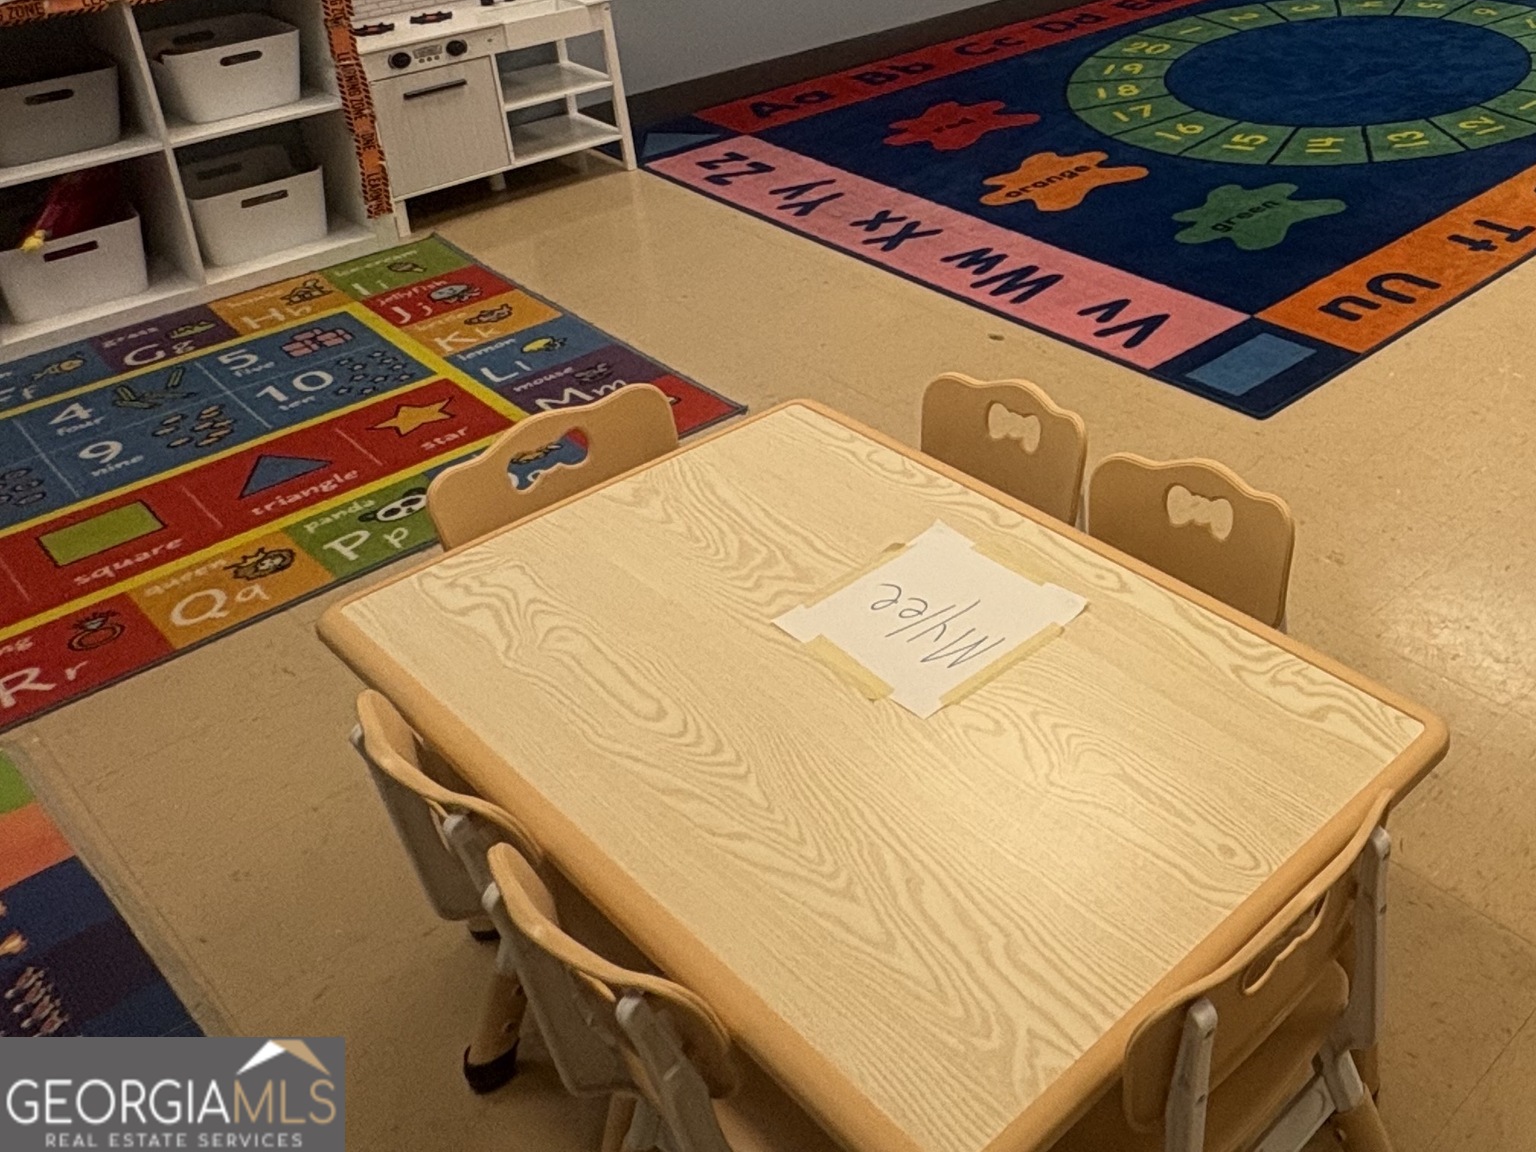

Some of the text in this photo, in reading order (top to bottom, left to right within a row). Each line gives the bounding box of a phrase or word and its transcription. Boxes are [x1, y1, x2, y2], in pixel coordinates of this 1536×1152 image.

[11, 2, 45, 20] ZONE
[1290, 3, 1322, 13] 3
[1355, 0, 1385, 9] 4
[1416, 1, 1447, 10] 5
[1471, 7, 1500, 18] 6
[1228, 11, 1260, 24] 2
[1178, 26, 1202, 36] 1
[1120, 40, 1172, 56] 20
[748, 89, 837, 120] Aa
[851, 60, 936, 87] Bb
[953, 35, 1027, 57] Cc
[1032, 11, 1108, 36] Dd
[1103, 61, 1145, 77] 19
[1096, 83, 1141, 100] 18
[351, 97, 368, 121] ZONE
[1112, 103, 1154, 123] 17
[1154, 121, 1206, 142] 16
[1457, 115, 1507, 137] 12
[361, 132, 377, 152] ONE
[1221, 132, 1270, 152] 15
[1303, 135, 1347, 155] 14
[1386, 129, 1431, 150] 13
[1004, 163, 1092, 199] orange
[1210, 197, 1281, 234] green
[1446, 218, 1536, 253] Tt
[695, 150, 1172, 349] Vv Ww Xx Yy Zz
[1317, 270, 1443, 323] Uu
[217, 348, 260, 372] 5
[458, 335, 516, 362] lemon
[255, 369, 334, 403] 10
[513, 365, 574, 393] mouse
[48, 401, 96, 426] 4
[56, 415, 105, 436] four
[420, 425, 469, 451] star
[78, 439, 124, 465] 9
[91, 453, 145, 478] nine
[251, 468, 359, 516] triangle
[303, 498, 377, 534] panda
[73, 537, 183, 587] square
[144, 557, 228, 598] queen
[869, 583, 1006, 669] Mylee
